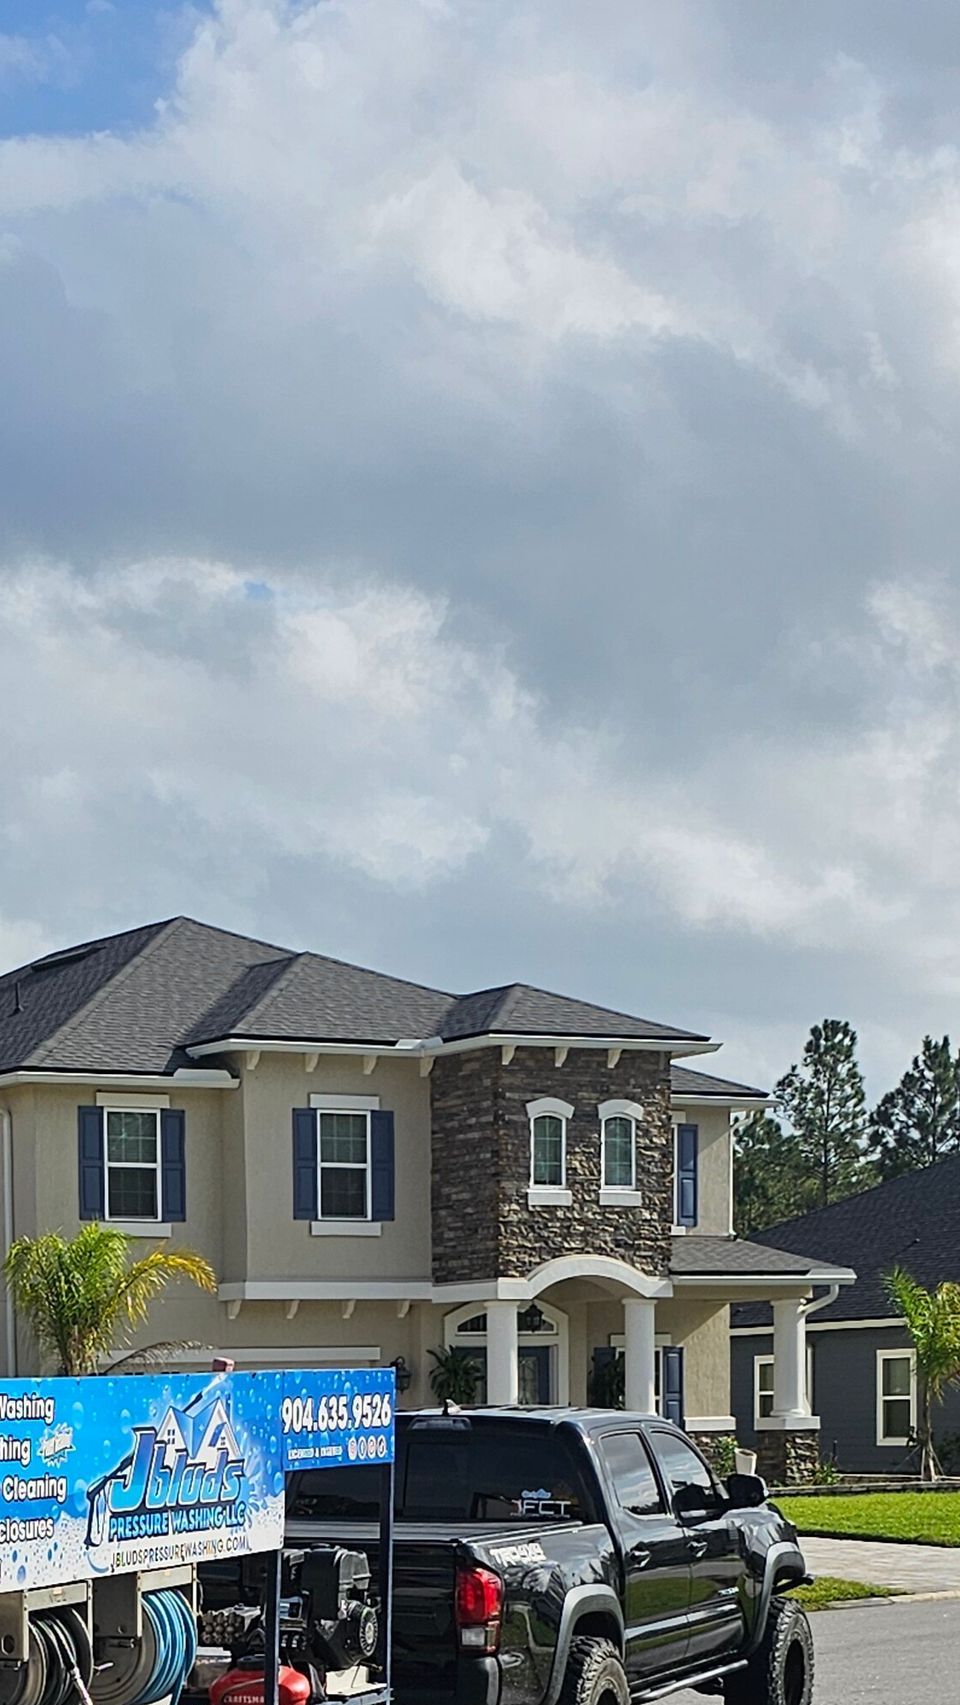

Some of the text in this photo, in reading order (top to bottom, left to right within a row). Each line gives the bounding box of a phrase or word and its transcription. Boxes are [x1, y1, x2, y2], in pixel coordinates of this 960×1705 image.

[281, 1393, 392, 1434] 904.635.9526
[2, 1474, 67, 1504] Cleaning
[107, 1427, 245, 1513] Jbluds
[108, 1501, 246, 1542] PRESSURE WASHING LLC
[223, 1694, 265, 1704] CRAFTSMA
